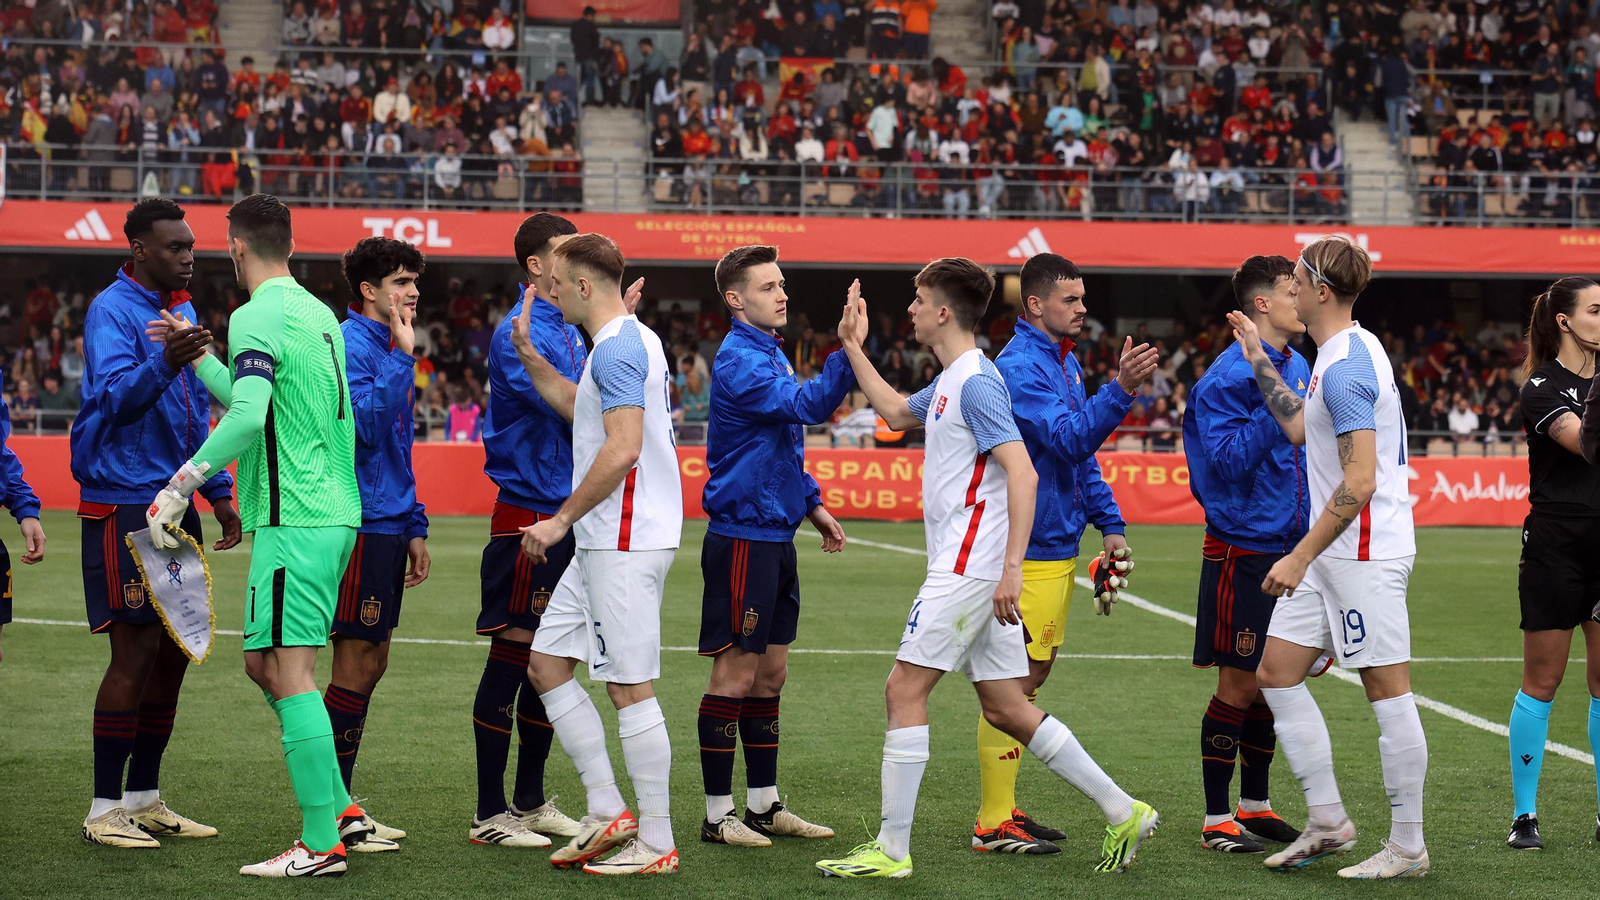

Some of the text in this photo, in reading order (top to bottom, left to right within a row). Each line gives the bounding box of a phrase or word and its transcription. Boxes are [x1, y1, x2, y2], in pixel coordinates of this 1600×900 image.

[362, 217, 452, 248] TCL
[635, 220, 806, 233] SELECCIÓN ESPAÑOLA
[680, 233, 765, 245] DE FÚTBOL
[1560, 235, 1600, 246] SELE
[694, 245, 726, 256] SUB
[322, 333, 345, 420] 1
[1429, 469, 1530, 504] Andaluc
[251, 586, 256, 623] 1
[1339, 609, 1366, 644] 19
